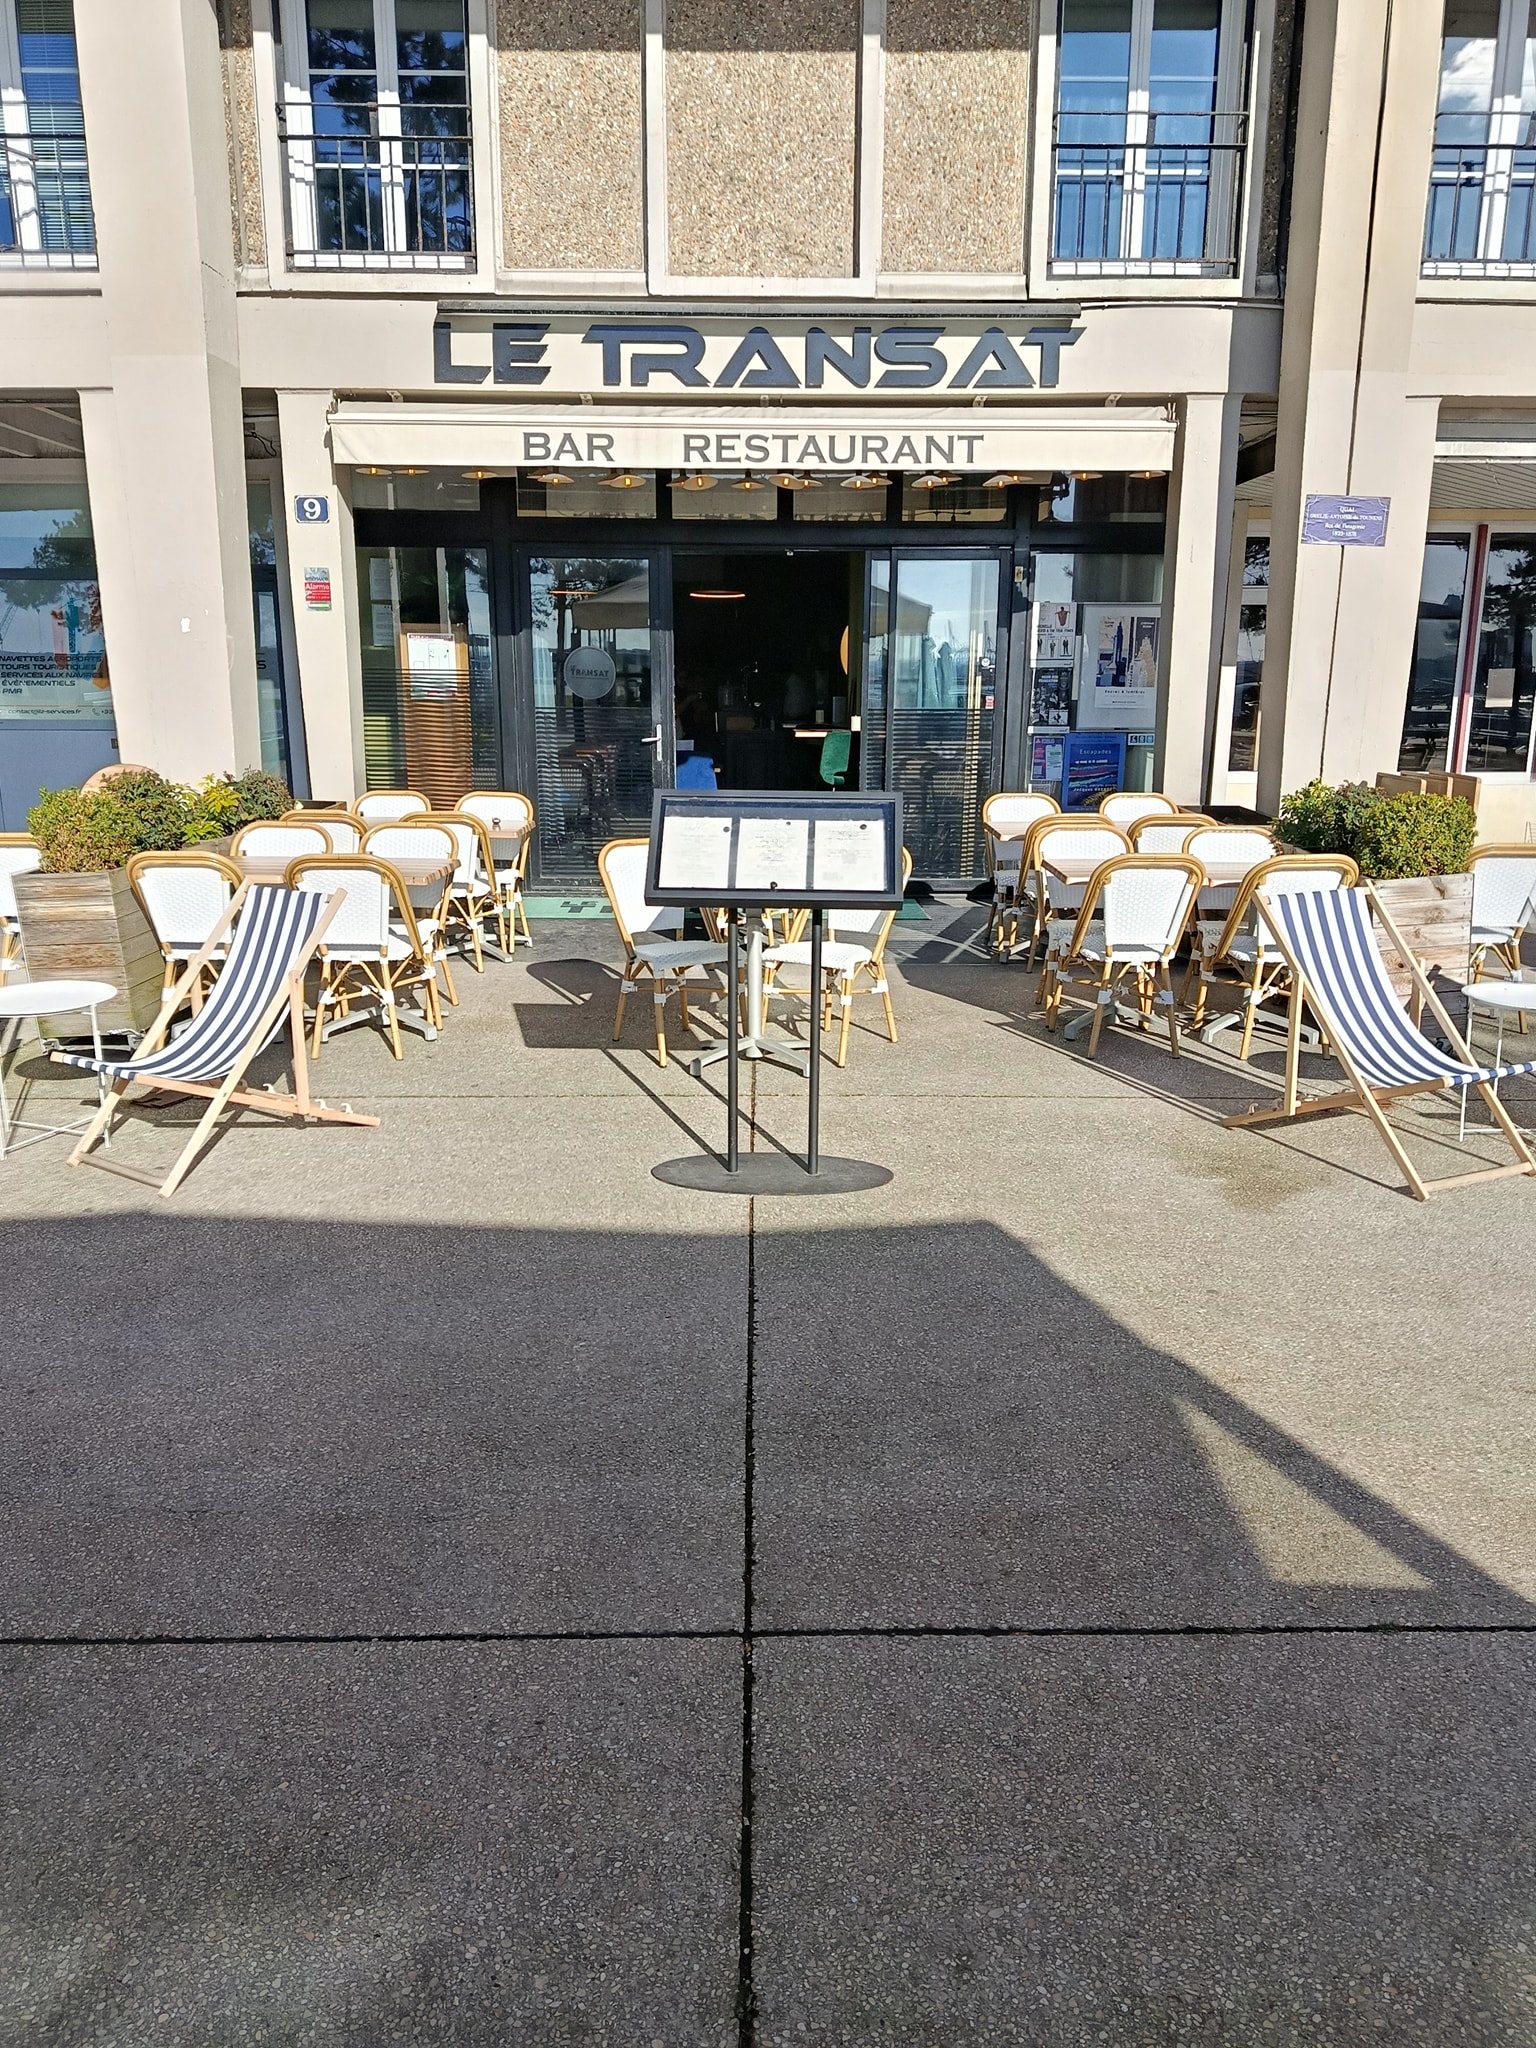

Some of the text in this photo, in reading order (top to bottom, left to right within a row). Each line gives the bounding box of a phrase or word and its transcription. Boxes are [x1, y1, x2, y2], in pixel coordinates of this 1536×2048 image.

[433, 322, 1086, 388] LE TRANSAT
[522, 431, 985, 465] BAR RESTAURANT
[303, 498, 321, 519] 9
[1, 671, 43, 679] SERVICES
[570, 668, 609, 677] TRANSAT
